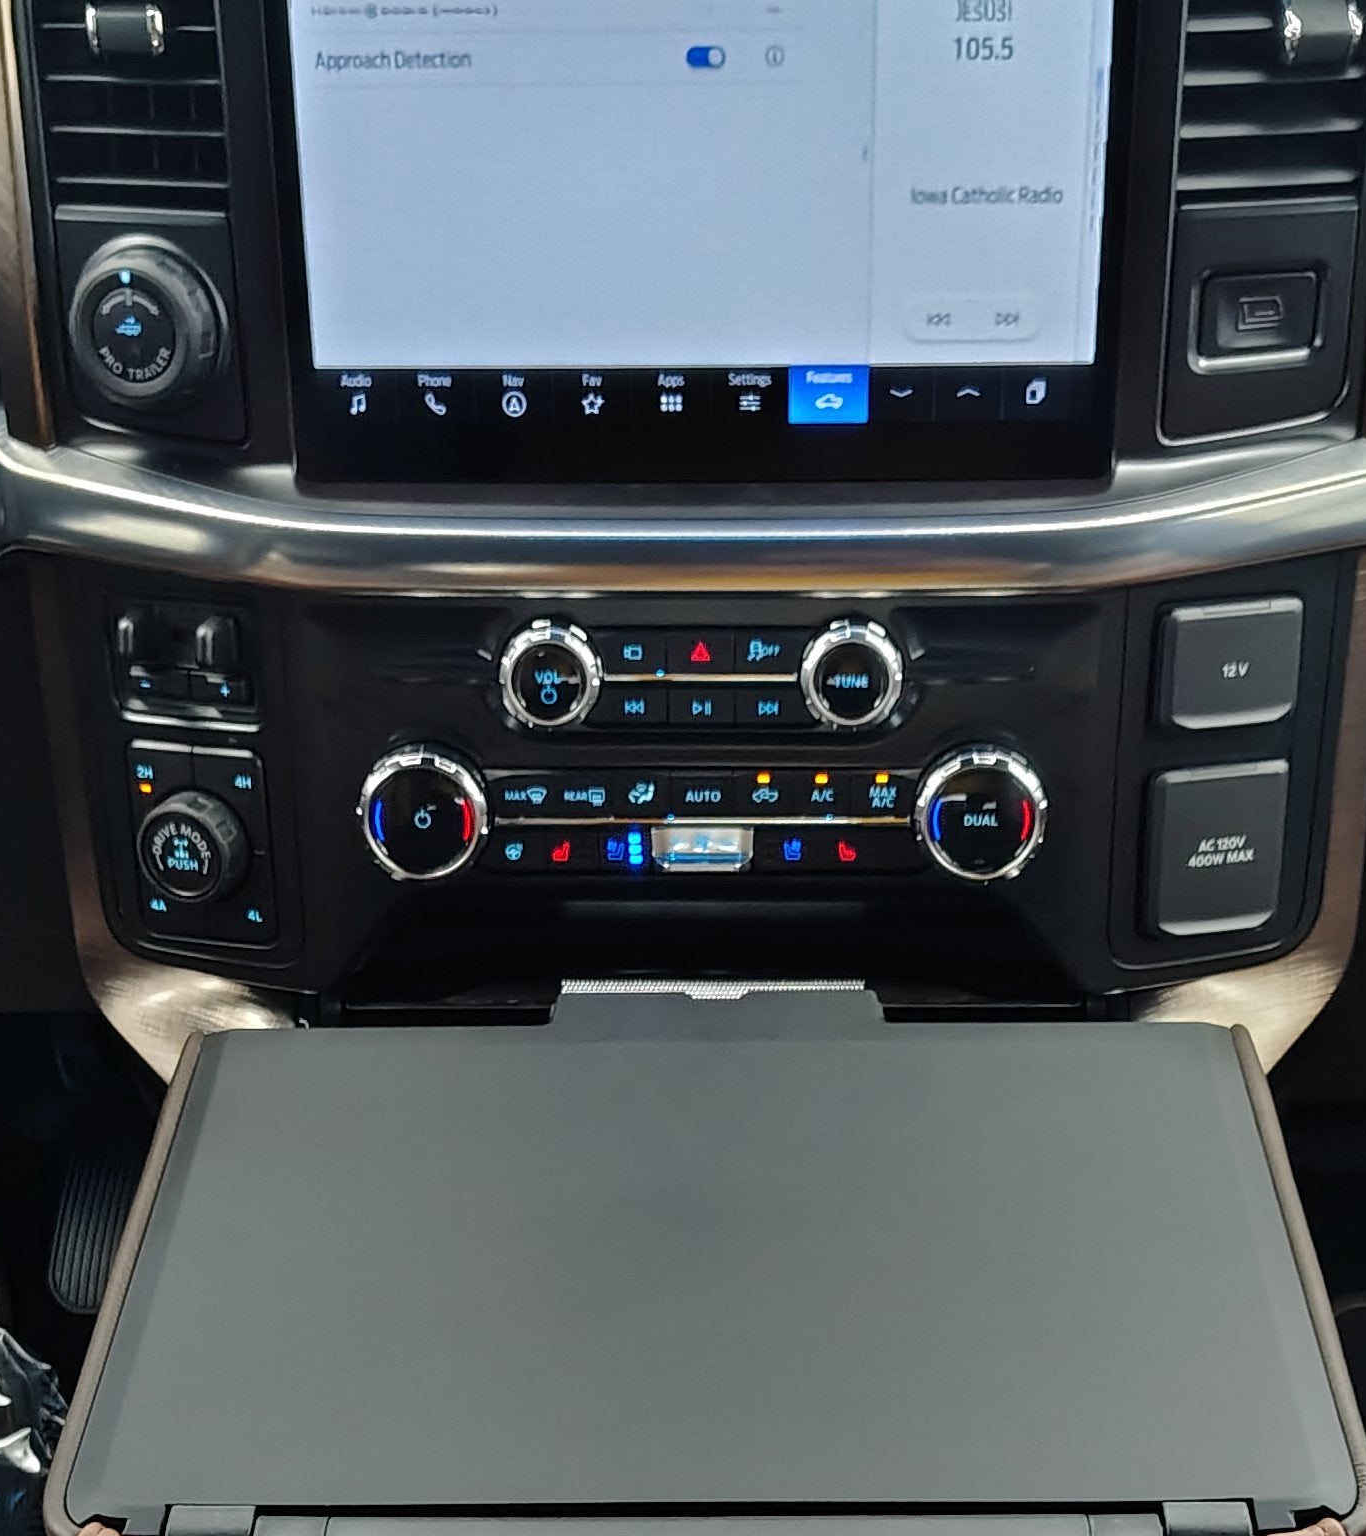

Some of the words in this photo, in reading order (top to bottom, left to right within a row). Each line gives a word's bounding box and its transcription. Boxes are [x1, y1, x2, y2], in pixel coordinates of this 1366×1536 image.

[954, 36, 1014, 61] 105.5
[315, 50, 391, 71] Approach
[394, 50, 472, 70] Detection
[910, 187, 948, 205] Iowa
[951, 186, 1016, 205] Catholic
[1018, 186, 1064, 205] Radio
[98, 346, 123, 374] PRO
[127, 347, 171, 380] TRAILER
[417, 373, 452, 388] Phone
[581, 373, 603, 388] Fav
[657, 373, 686, 389] Apps
[727, 372, 773, 388] Settings
[534, 669, 562, 685] VOL
[834, 673, 870, 689] TUNE
[136, 764, 154, 780] 2H
[234, 774, 252, 790] 4H
[504, 789, 527, 802] MAX
[563, 789, 588, 802] REAR
[685, 789, 722, 803] AUTO
[810, 788, 834, 803] A/C
[868, 785, 897, 799] MAX
[871, 797, 895, 809] A/C
[963, 813, 999, 828] DUAL
[152, 822, 178, 855] DRIVE
[180, 822, 212, 859] MODE
[1198, 838, 1216, 853] AC
[1217, 834, 1247, 851] 120V
[167, 856, 199, 872] PUSH
[1186, 852, 1226, 868] 400W
[1226, 848, 1255, 864] MAX
[150, 899, 167, 912] 4A
[247, 908, 264, 922] 4L
